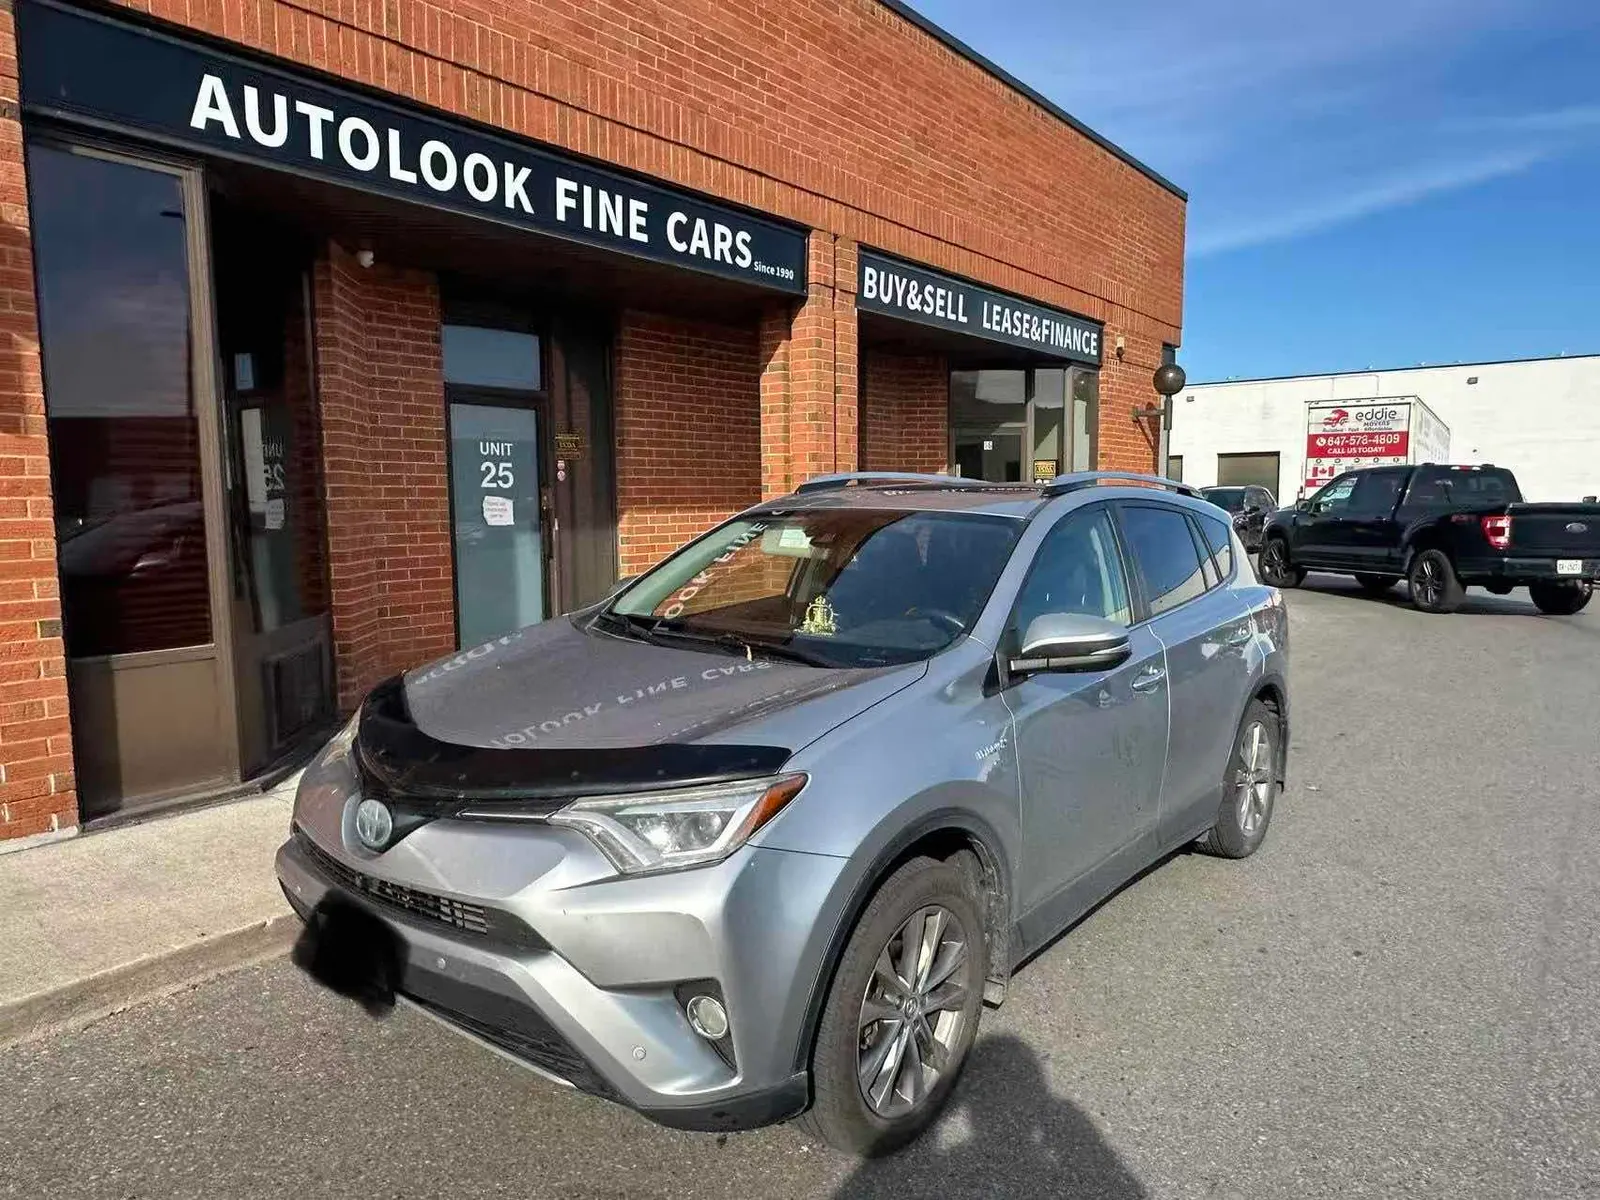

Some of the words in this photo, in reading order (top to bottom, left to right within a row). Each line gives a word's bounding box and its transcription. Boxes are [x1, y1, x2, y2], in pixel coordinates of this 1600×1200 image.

[189, 73, 535, 216] AUTOLOOK
[555, 176, 650, 243] FINE
[666, 211, 753, 269] CARS
[753, 261, 776, 275] Since
[776, 266, 794, 280] 1990
[863, 266, 969, 324] BUY&SELL
[982, 300, 1099, 356] LEASE&FINANCE
[1356, 407, 1396, 421] eddie
[480, 441, 513, 457] UNIT
[481, 461, 514, 489] 25
